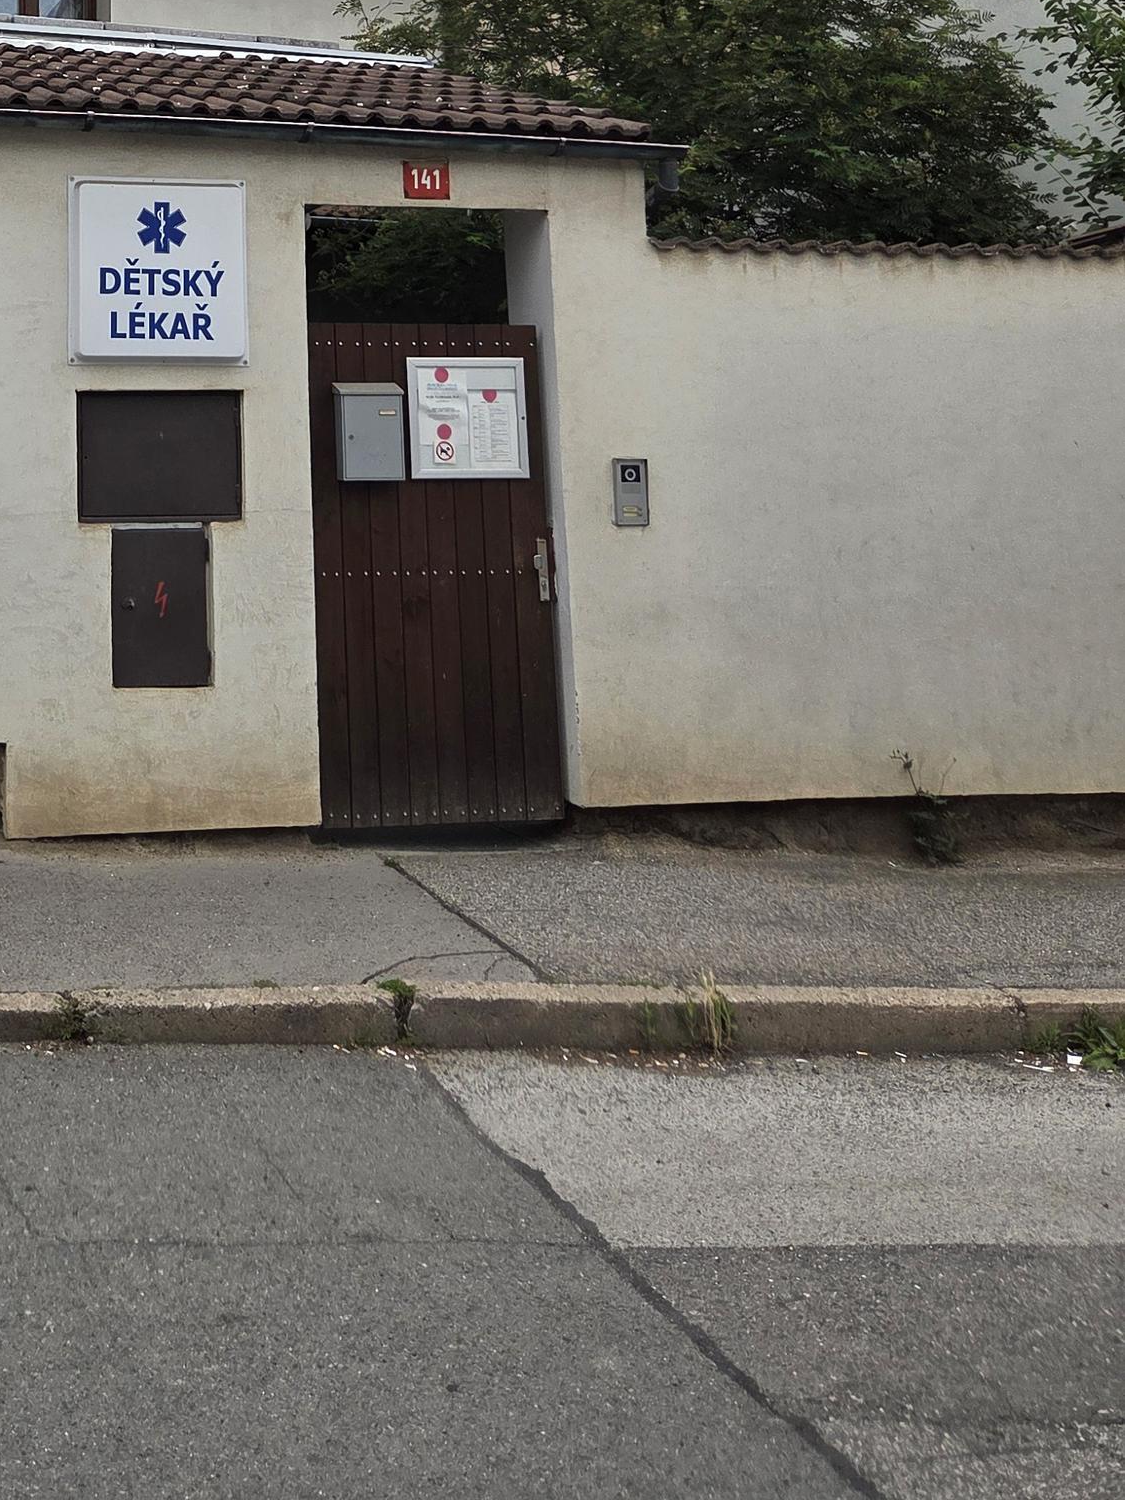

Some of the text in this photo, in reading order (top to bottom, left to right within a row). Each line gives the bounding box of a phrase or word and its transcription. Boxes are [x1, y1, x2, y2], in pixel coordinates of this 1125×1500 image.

[411, 168, 440, 190] 141
[99, 258, 225, 297] DĚTSKÝ
[110, 302, 214, 341] LÉKAŘ
